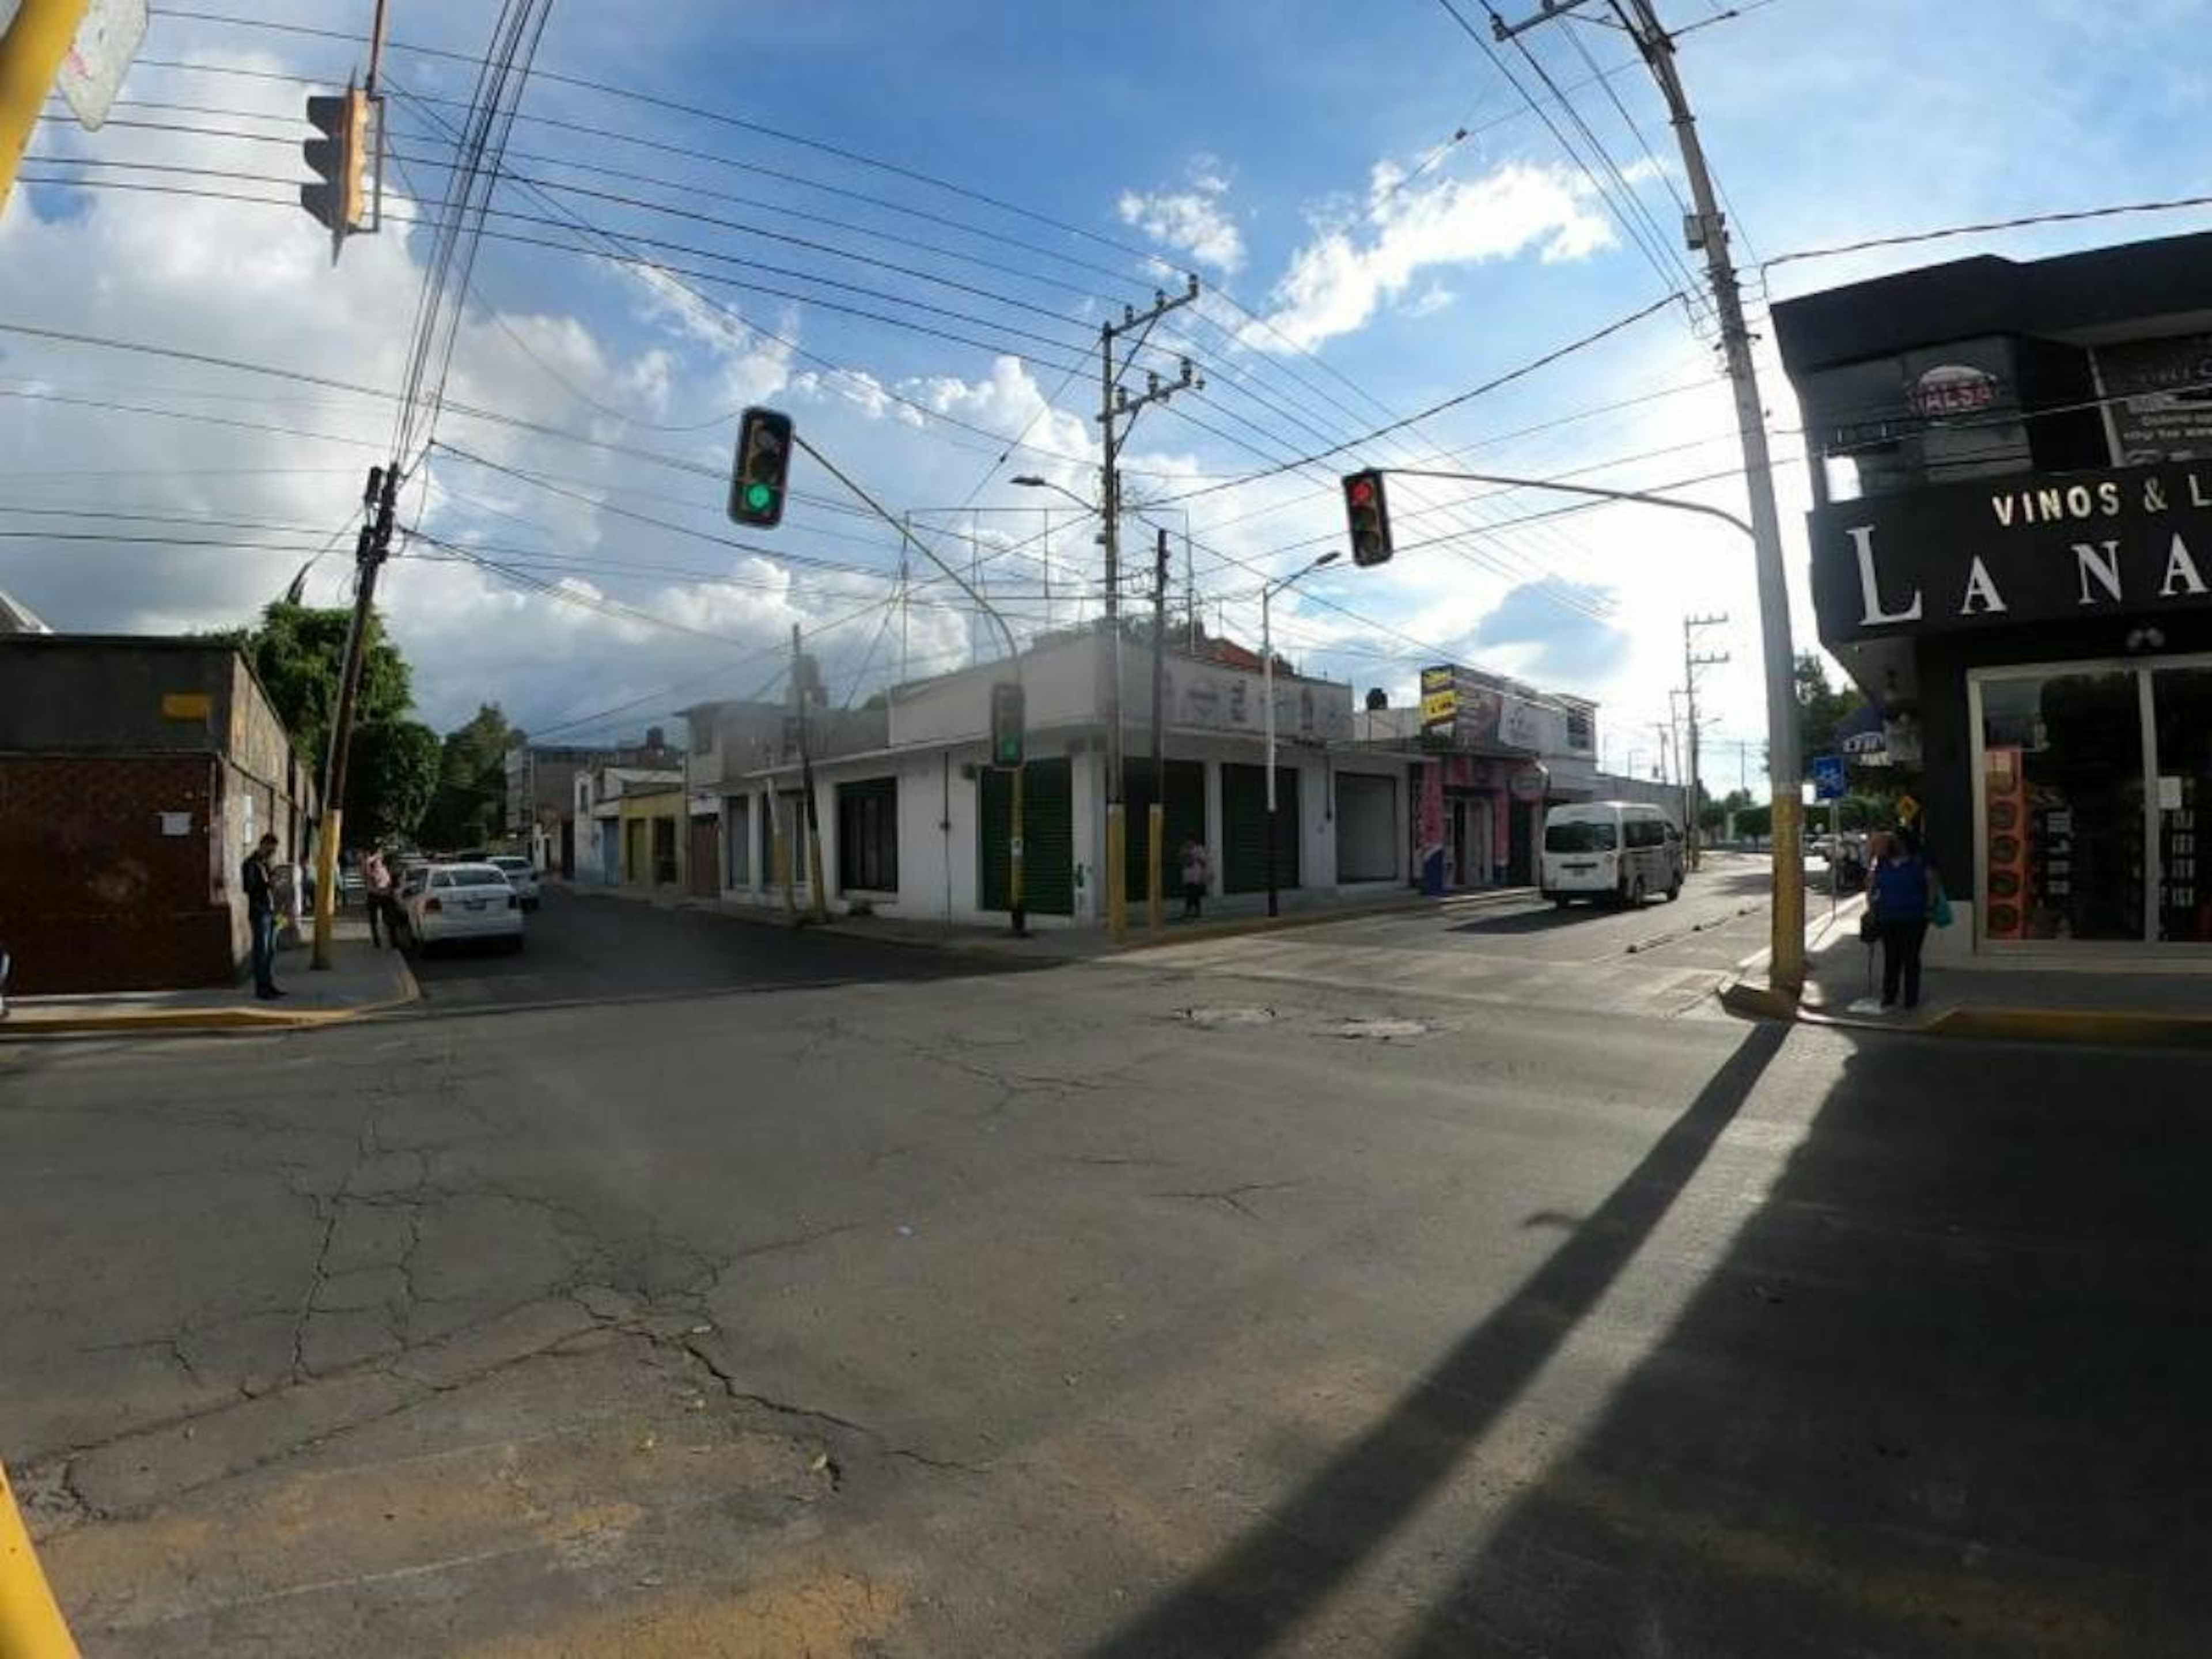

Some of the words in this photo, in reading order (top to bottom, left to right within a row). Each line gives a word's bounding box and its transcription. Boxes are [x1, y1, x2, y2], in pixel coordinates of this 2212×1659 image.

[1991, 482, 2120, 527] VINOS
[2143, 476, 2169, 513] &
[1846, 524, 2008, 627] LA
[2071, 532, 2212, 604] NA
